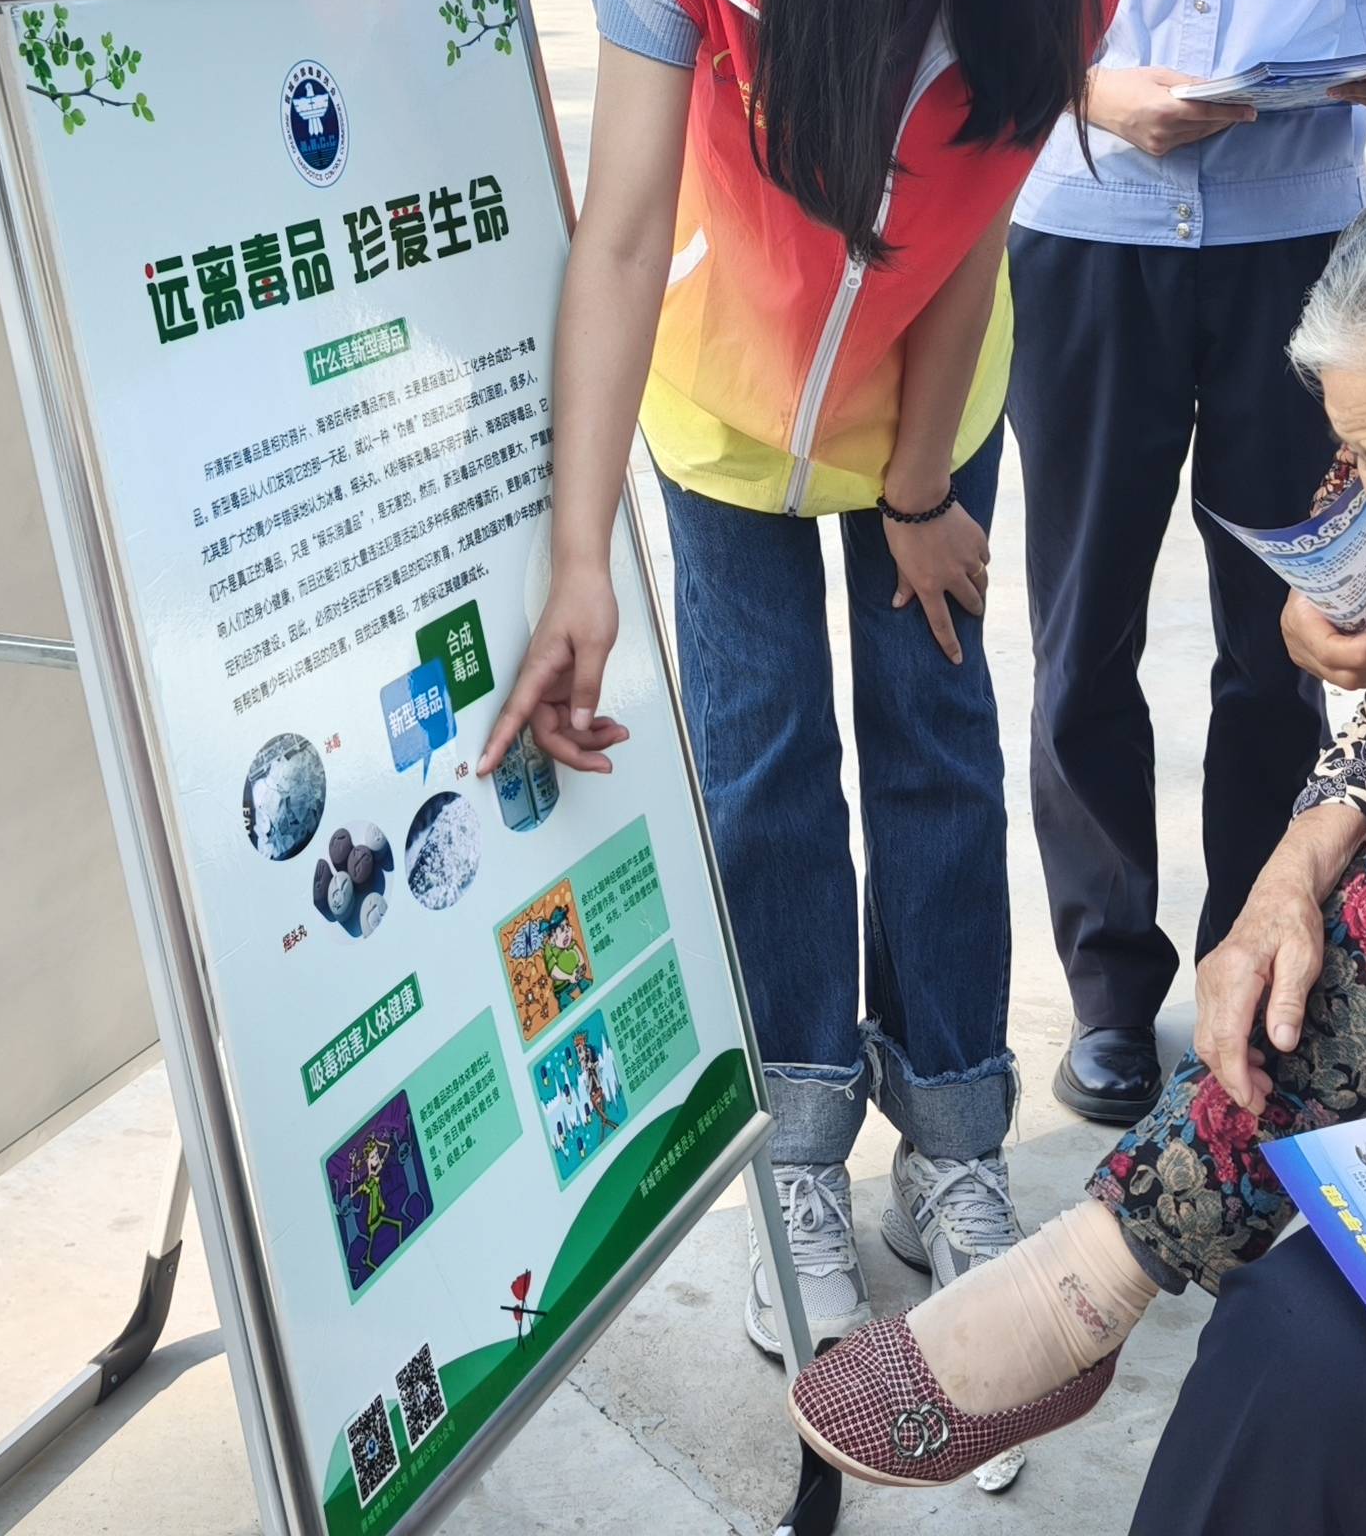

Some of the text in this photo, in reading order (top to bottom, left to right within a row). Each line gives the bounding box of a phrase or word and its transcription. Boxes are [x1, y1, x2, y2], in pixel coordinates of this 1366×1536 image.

[144, 174, 510, 344] 远离毒品 珍爱生命
[311, 323, 406, 379] 什么是新型毒品
[444, 619, 475, 658] 合成
[450, 646, 480, 685] 毒品
[387, 682, 444, 740] 新型毒品
[323, 731, 342, 756] 冰毒
[453, 759, 470, 782] K粉
[281, 921, 308, 955] 摇头丸
[307, 981, 416, 1096] 吸毒损害人体健康
